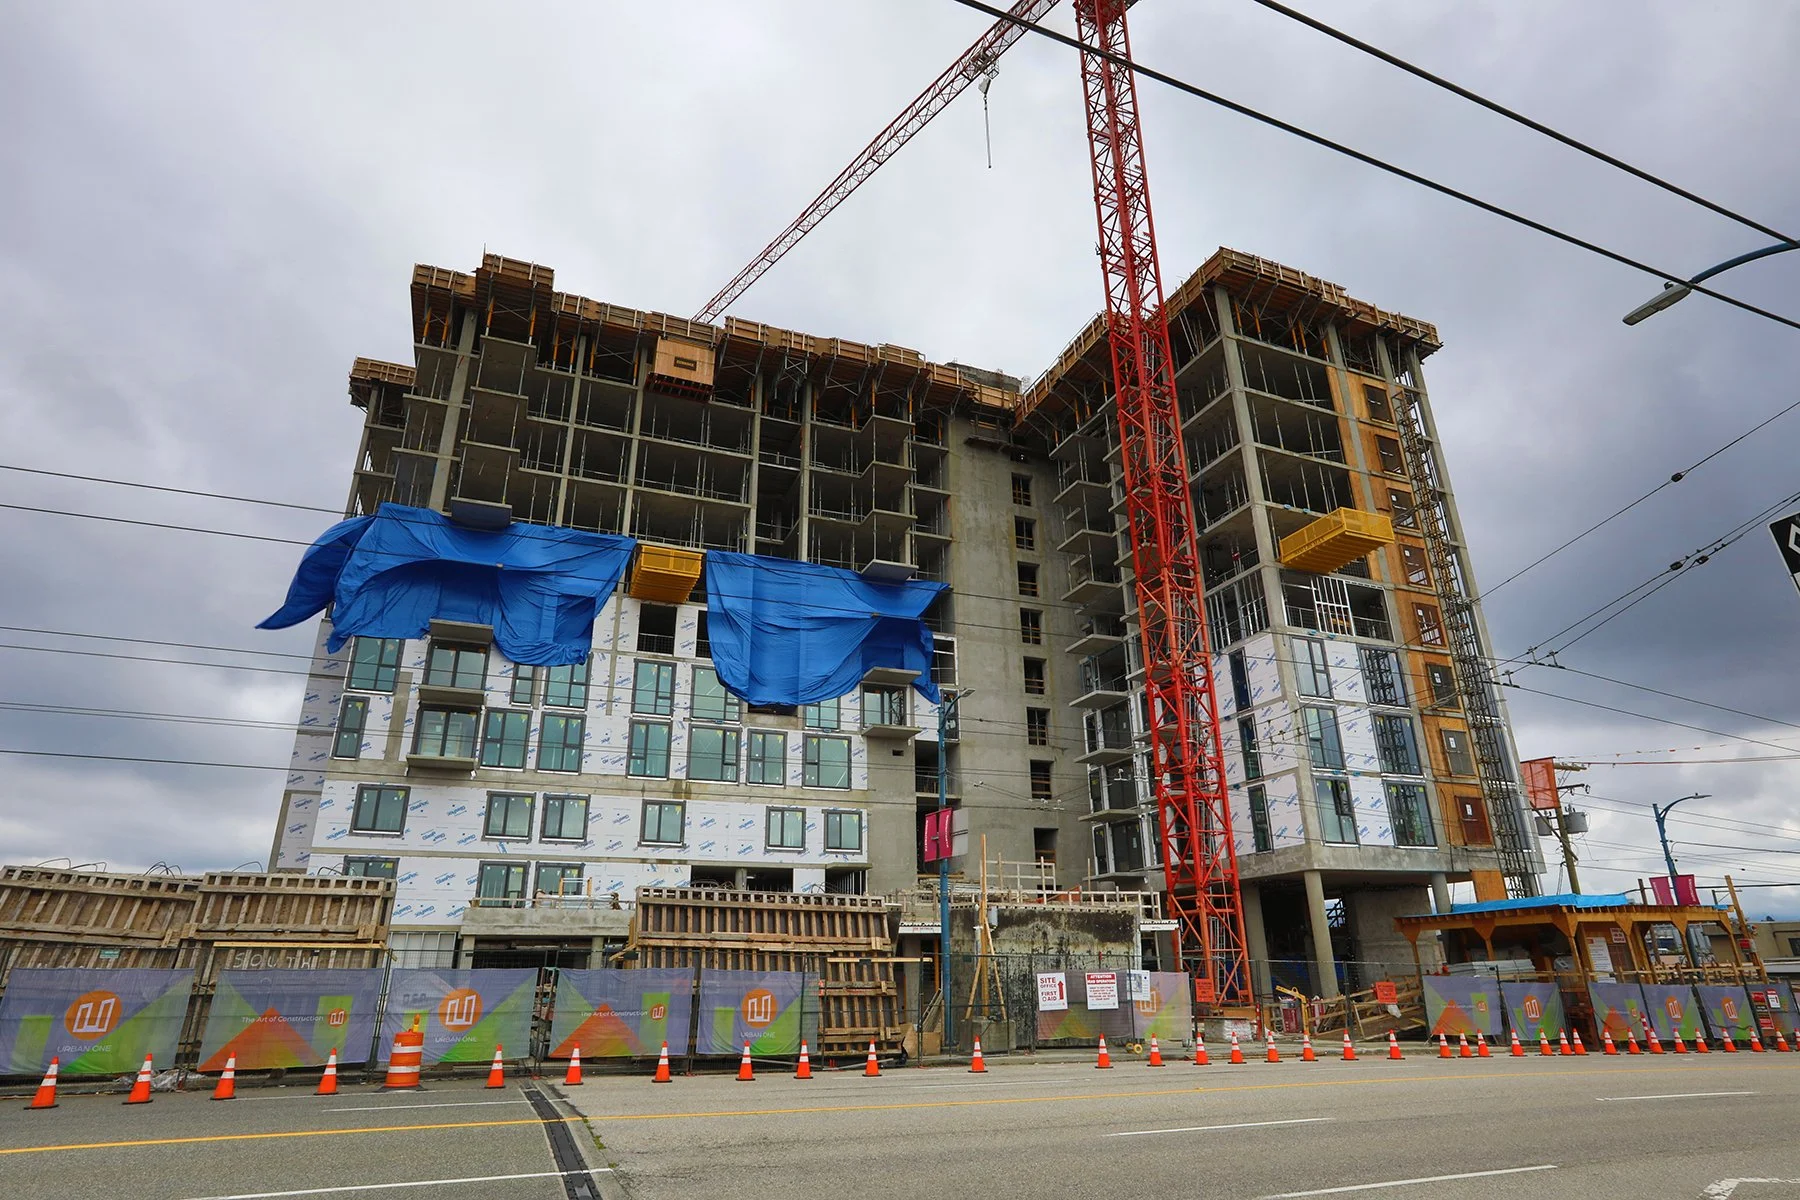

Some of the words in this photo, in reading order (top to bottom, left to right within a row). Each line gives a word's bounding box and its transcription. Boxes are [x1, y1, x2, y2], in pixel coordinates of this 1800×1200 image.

[232, 952, 312, 969] SOUTH
[56, 1045, 90, 1053] URBAN
[91, 1044, 112, 1052] ONE
